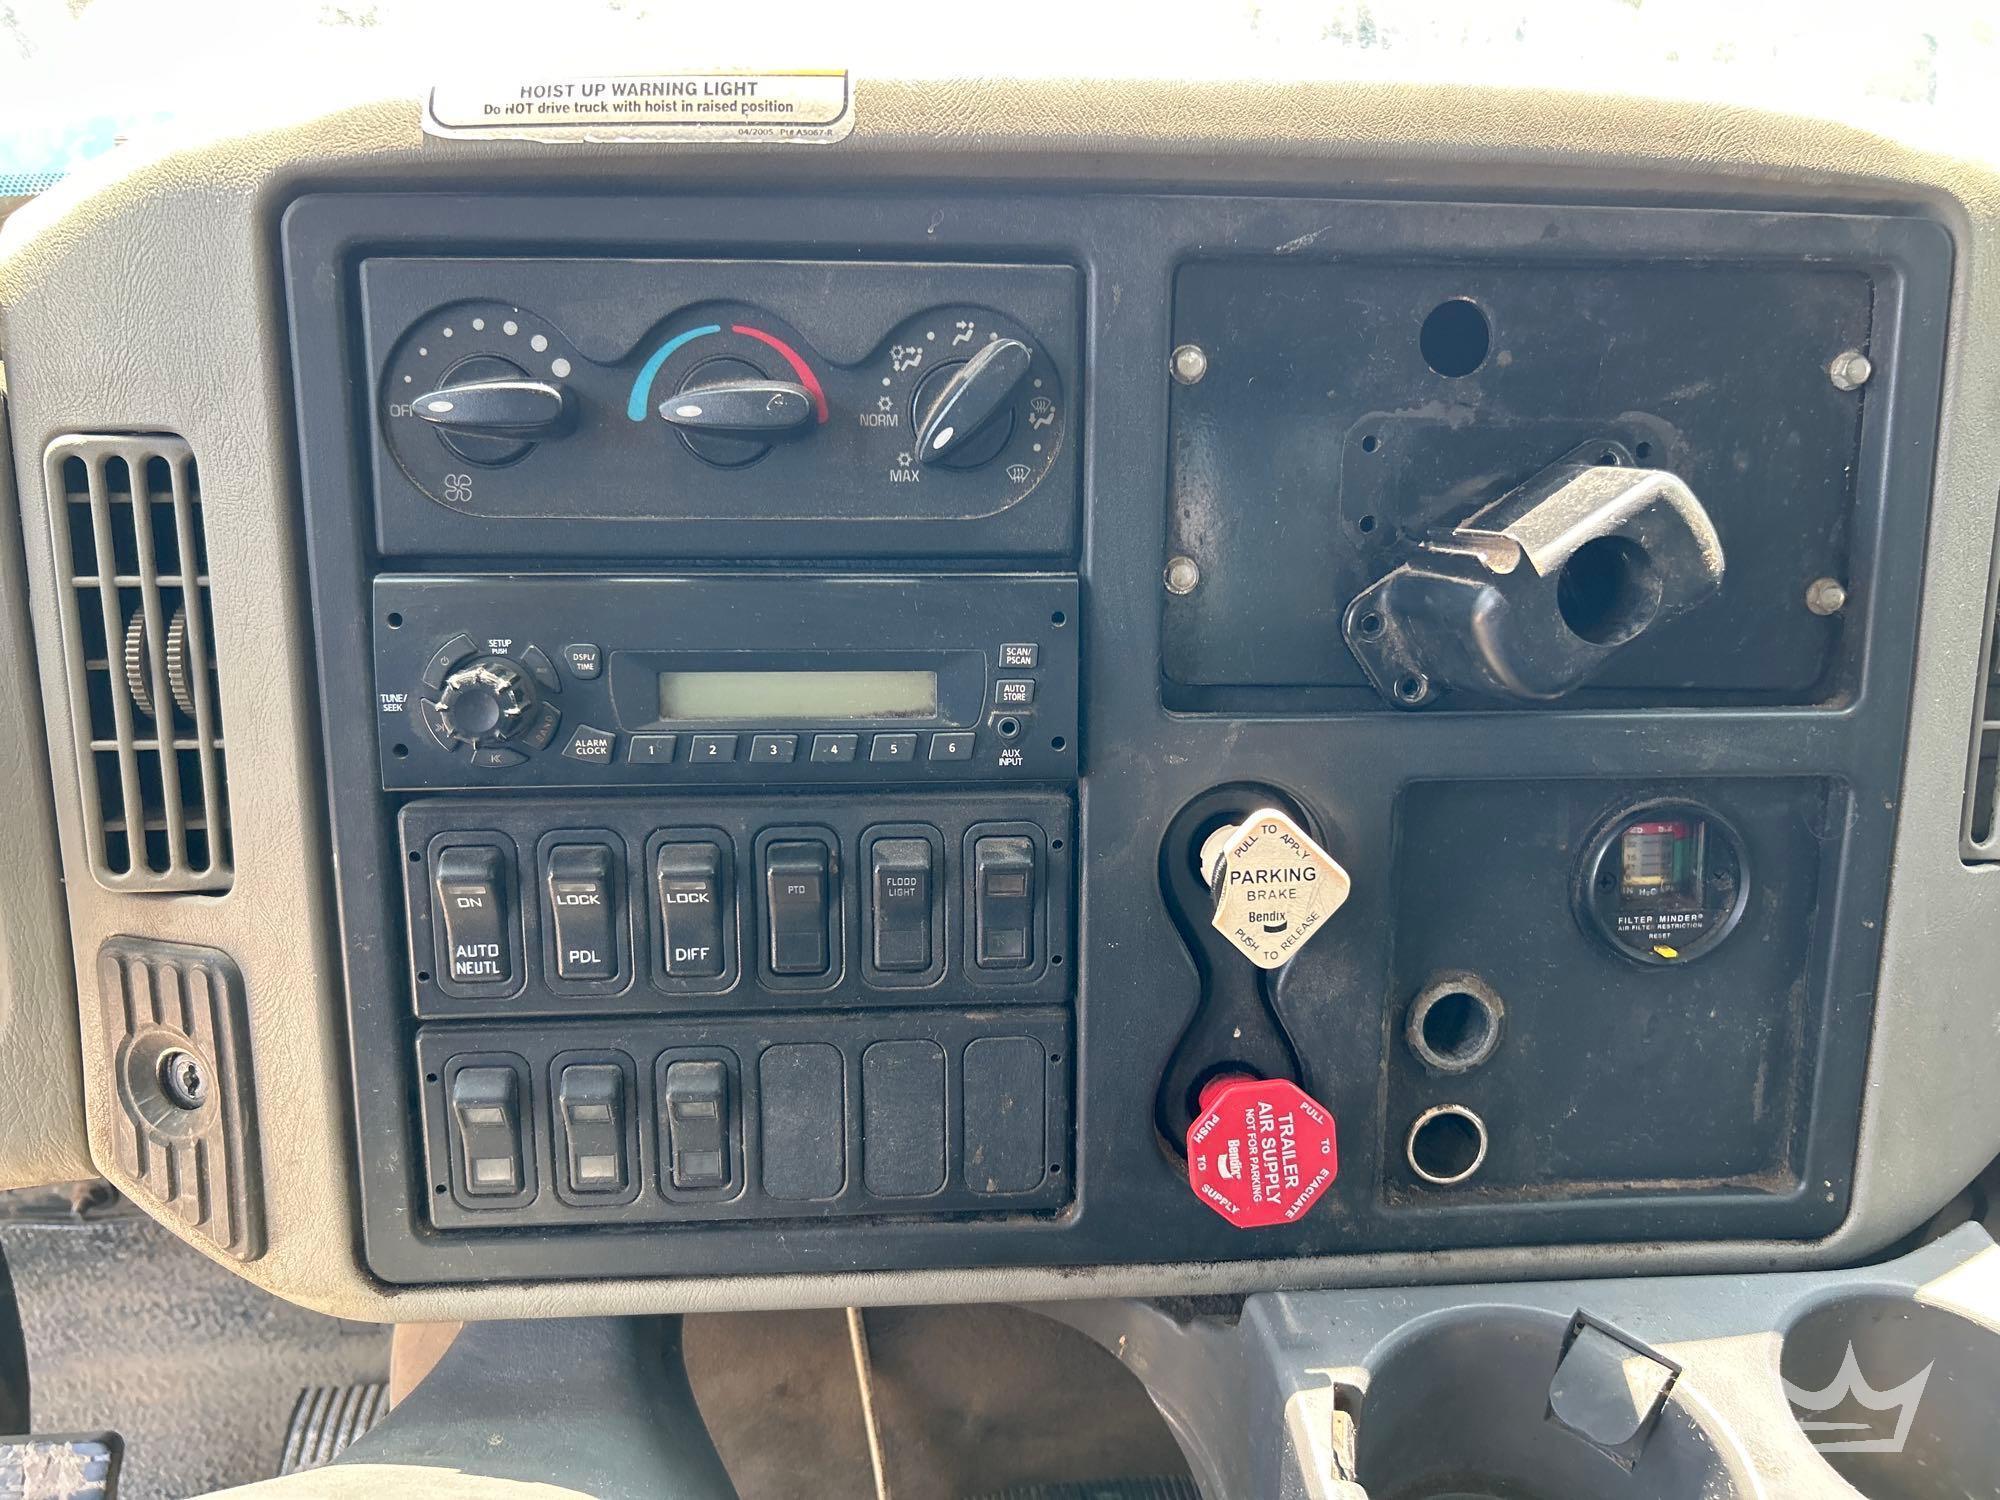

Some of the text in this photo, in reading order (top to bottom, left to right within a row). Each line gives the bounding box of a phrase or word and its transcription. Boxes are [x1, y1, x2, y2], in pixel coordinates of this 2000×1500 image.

[520, 81, 758, 99] HOIST UP WARNING LIGHT
[484, 100, 793, 115] Do NOT drive truck with hoist in raised position
[738, 128, 773, 136] 04/2005
[859, 414, 899, 427] NORM
[889, 470, 920, 482] MAX
[488, 639, 512, 648] SETUP
[573, 653, 595, 661] DSPL/
[1006, 647, 1032, 656] SCAN/
[1006, 656, 1031, 665] PSCAN
[577, 663, 595, 671] TIME
[1004, 684, 1026, 693] AUTO
[380, 693, 408, 703] TUNE/
[1003, 693, 1026, 701] STORE
[383, 704, 403, 712] SEEK
[575, 739, 608, 747] ALARM
[890, 743, 898, 754] 5
[948, 742, 956, 753] 6
[576, 747, 607, 755] CLOCK
[648, 745, 654, 755] 1
[709, 745, 717, 755] 2
[769, 744, 777, 755] 3
[830, 744, 839, 755] 4
[1001, 749, 1021, 758] AUX
[999, 758, 1023, 766] INPUT
[1234, 824, 1311, 860] PULL TO APPLY
[886, 877, 917, 886] FLOOD
[1230, 867, 1316, 885] PARKING
[788, 885, 806, 894] PTO
[888, 888, 915, 897] LIGHT
[1247, 888, 1297, 901] BRAKE
[457, 897, 483, 908] ON
[557, 894, 600, 905] LOCK
[667, 892, 710, 903] LOCK
[1248, 911, 1286, 922] Bendix
[1618, 915, 1653, 924] FILTER
[1657, 922, 1703, 930] RESTRICTION
[1234, 911, 1320, 960] PUSH TO RELEASE
[456, 944, 499, 957] AUTO
[675, 947, 710, 961] DIFF
[569, 950, 601, 963] PDL
[456, 961, 500, 974] NEUTL
[1245, 1108, 1263, 1203] NOT FOR PARKING
[1257, 1101, 1281, 1205] AIR SUPPLY
[1278, 1112, 1299, 1189] TRAILER
[1193, 1113, 1241, 1215] PUSH TO SUPPLY
[1285, 1101, 1330, 1219] PULL TO EVACUATE
